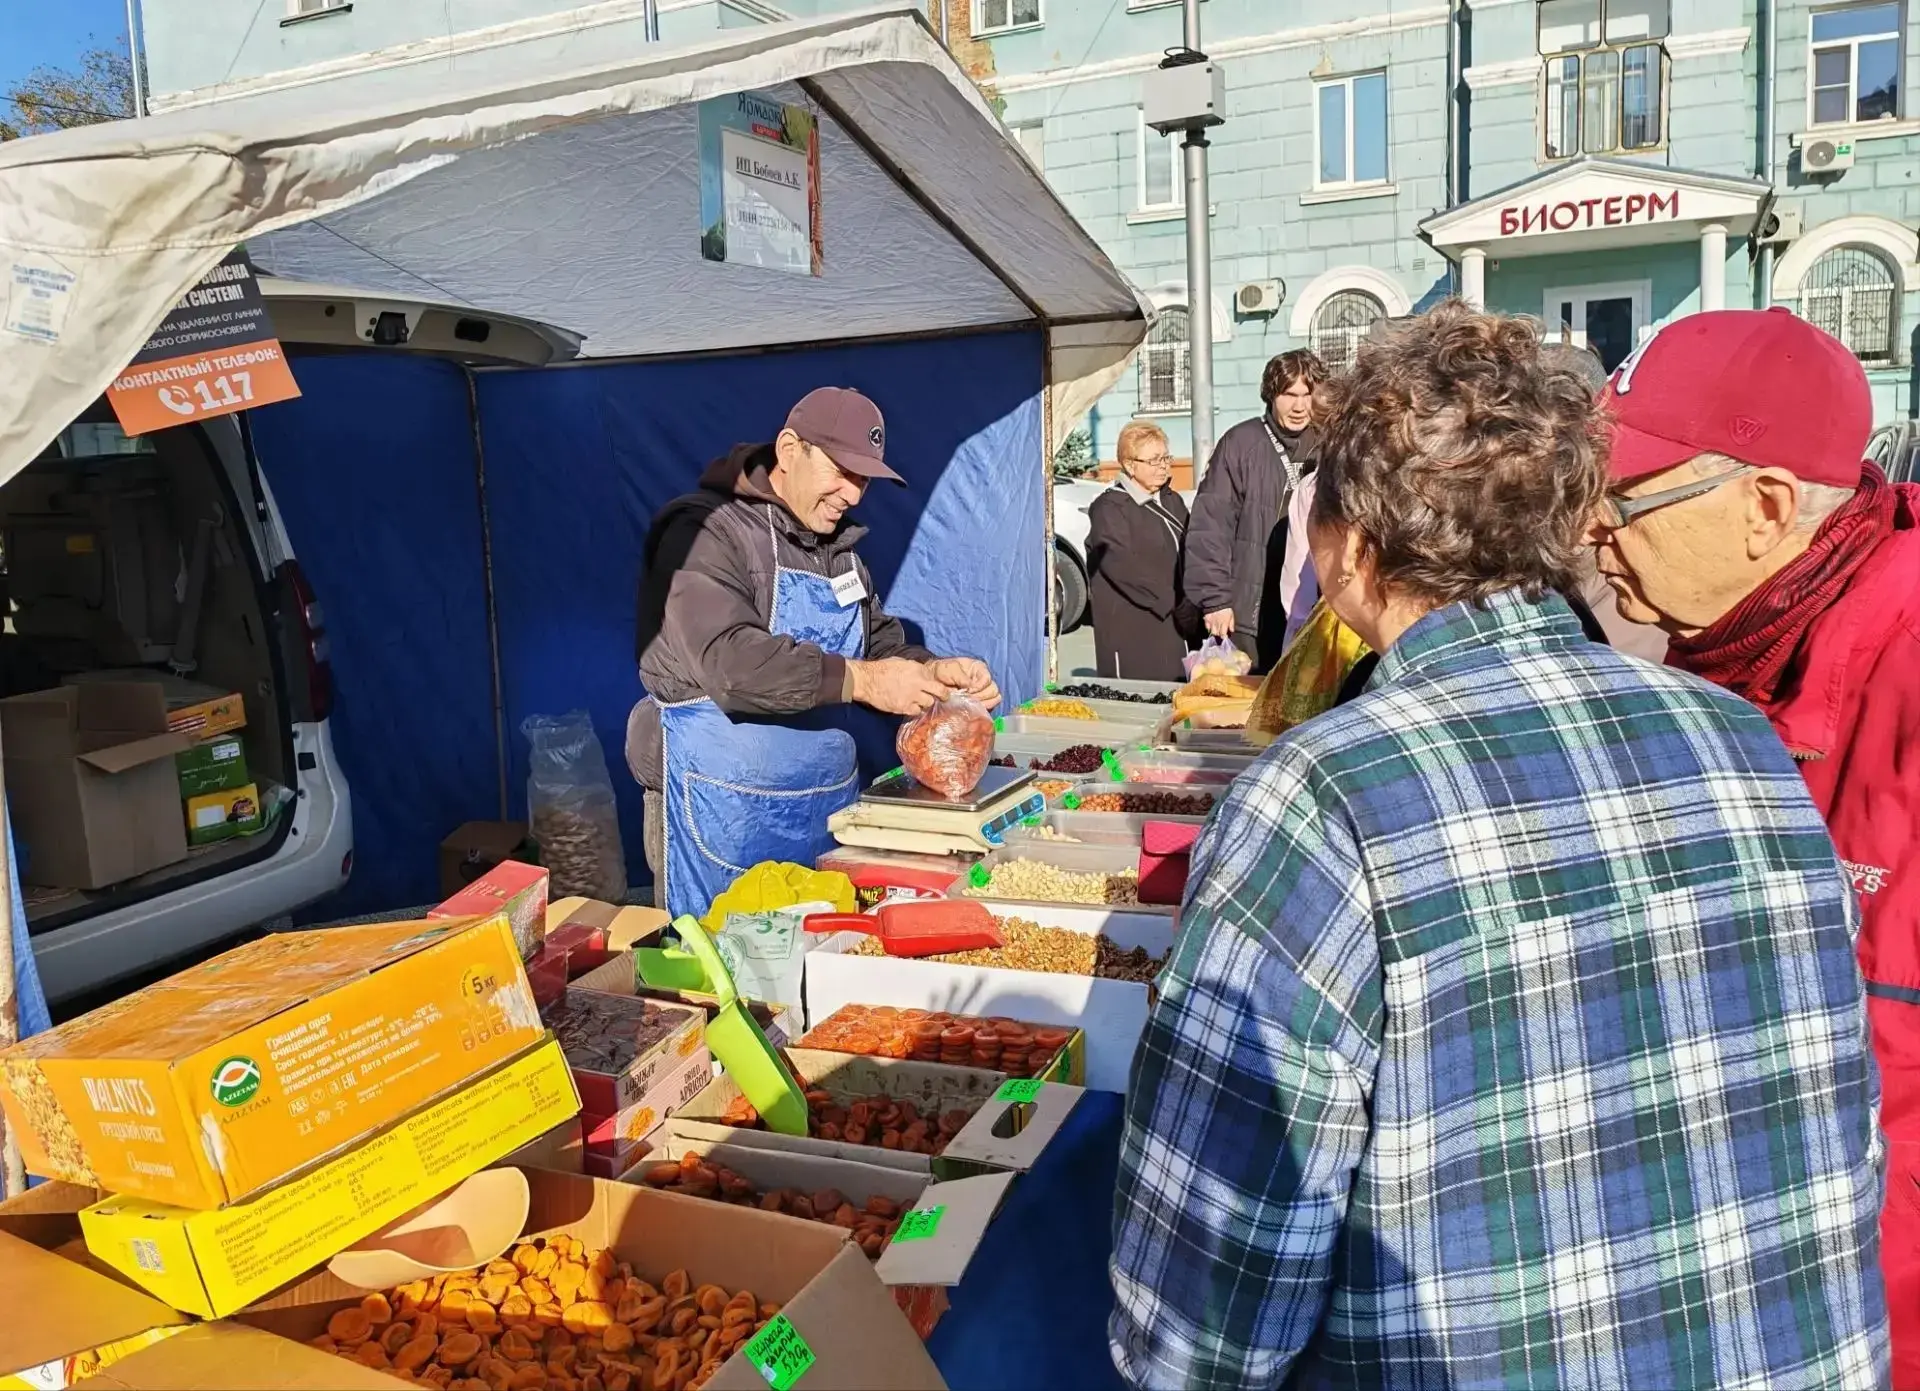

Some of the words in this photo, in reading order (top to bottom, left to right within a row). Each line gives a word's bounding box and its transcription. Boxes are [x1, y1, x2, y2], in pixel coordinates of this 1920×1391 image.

[1500, 190, 1679, 236] БИОТЕРМ
[189, 284, 244, 307] СИСТЕМ!
[177, 314, 222, 331] УДАЛЕНИИ
[222, 311, 233, 322] ОТ
[235, 308, 263, 320] ЛИНИИ
[143, 337, 175, 351] ОЕВОГО
[176, 322, 257, 344] СОПРИКОСНОВЕНИЯ
[114, 357, 211, 392] КОНТАКТНЫЙ
[213, 348, 279, 369] ТЕЛЕФОН:
[194, 371, 254, 411] 117
[471, 975, 483, 994] 5
[483, 975, 494, 987] кг
[265, 1022, 307, 1050] Грецкий
[308, 1012, 332, 1032] орех
[271, 1026, 328, 1061] очищенный
[360, 1058, 382, 1076] Дата
[80, 1077, 156, 1117] WALNUTS
[223, 1082, 257, 1104] AZIZTAM
[680, 1070, 708, 1103] APRICOT
[222, 1096, 271, 1124] AZIZTAM
[408, 1114, 430, 1132] Dried
[431, 1097, 463, 1122] apricots
[463, 1082, 493, 1101] without
